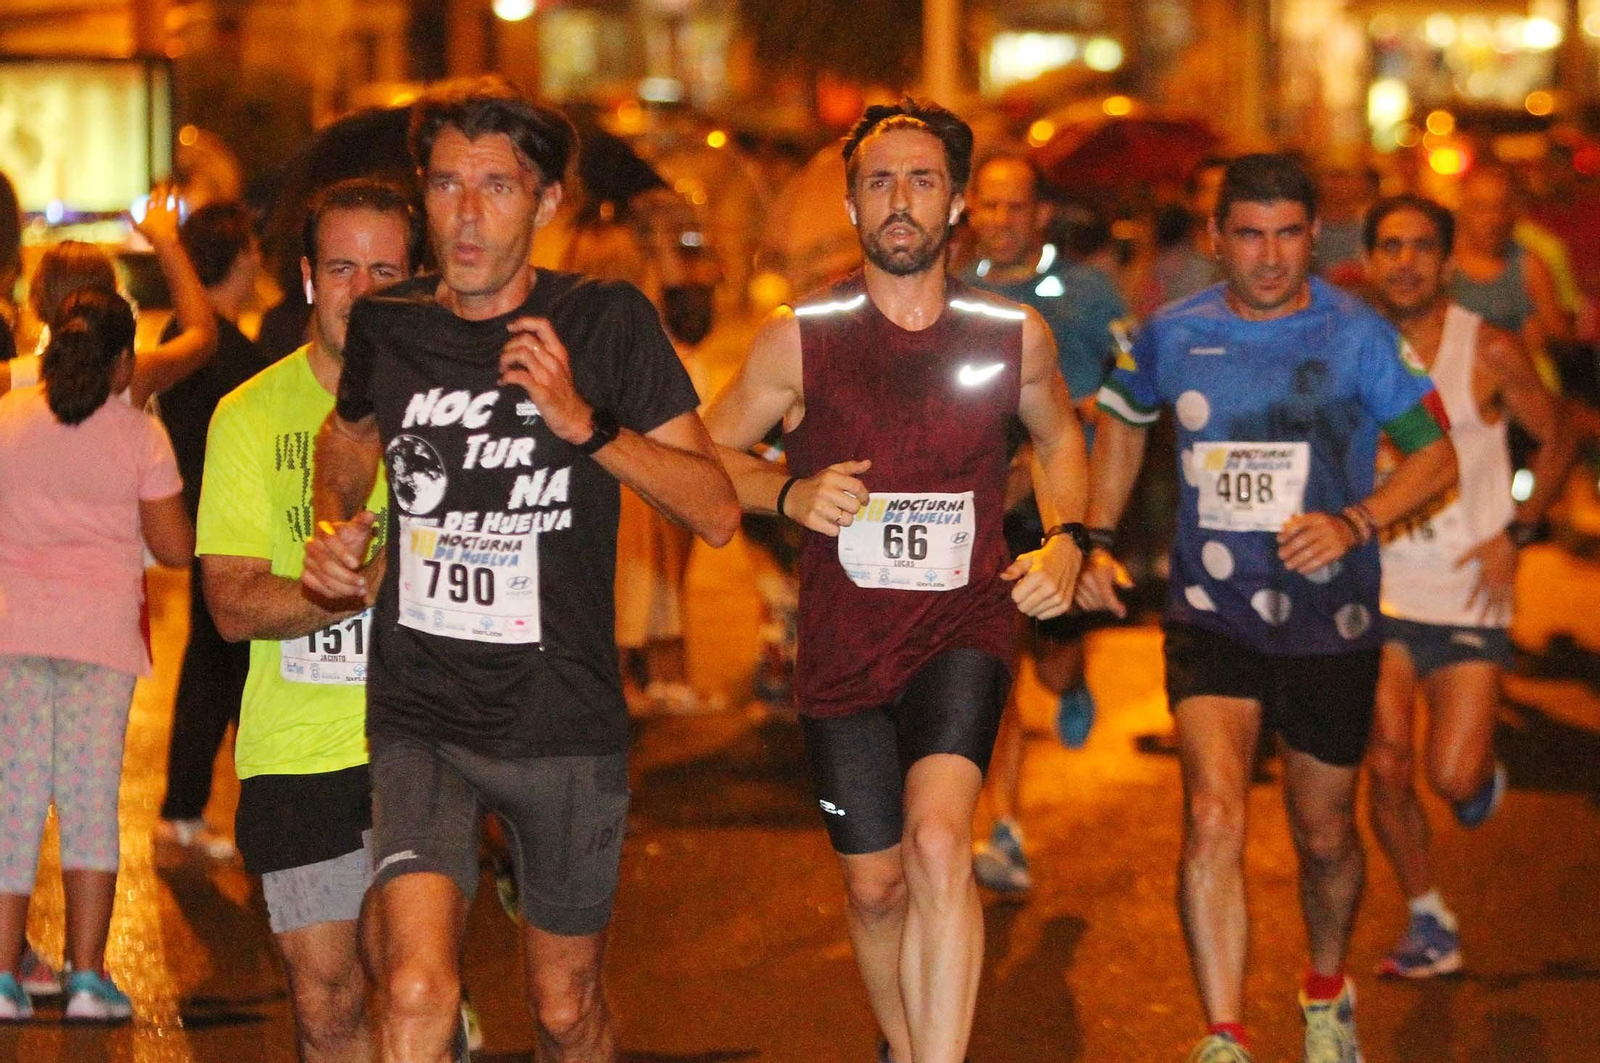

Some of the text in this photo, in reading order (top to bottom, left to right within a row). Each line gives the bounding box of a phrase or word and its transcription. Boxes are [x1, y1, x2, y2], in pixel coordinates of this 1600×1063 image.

[402, 387, 499, 429] NOC
[463, 433, 537, 469] TUR
[508, 466, 572, 510] NA
[1216, 473, 1273, 503] 408
[881, 511, 962, 525] DE HUELVA
[886, 499, 965, 512] NOCTURNA
[443, 511, 478, 532] DE
[479, 508, 572, 535] HUELVA
[437, 533, 523, 552] NOCTURNA
[883, 524, 928, 560] 66
[433, 546, 519, 567] DE HUELVA
[894, 560, 916, 568] LUCAS
[423, 559, 495, 607] 790
[308, 619, 364, 655] 151
[320, 654, 346, 663] JACINTO
